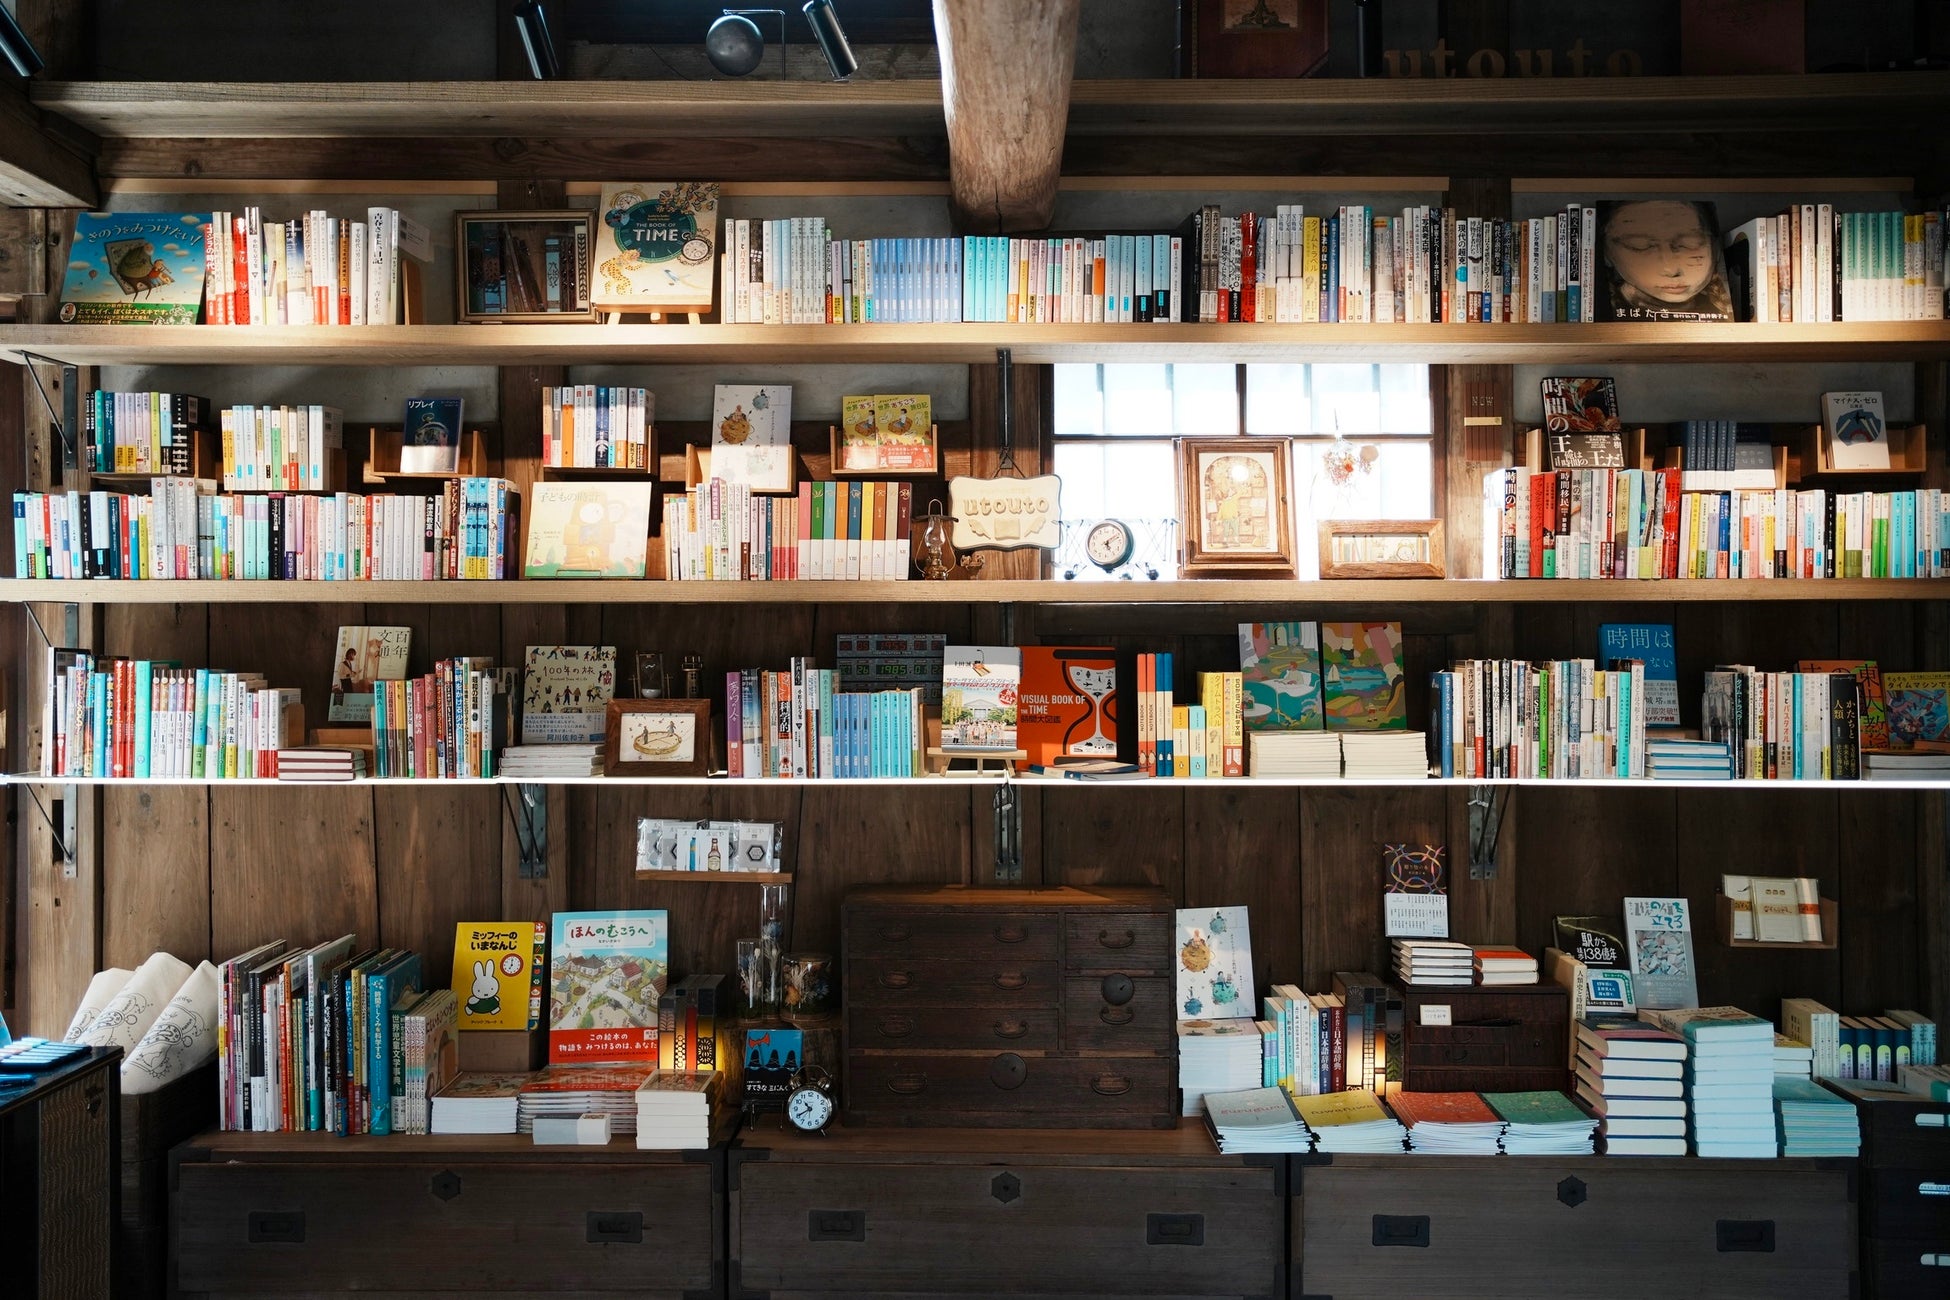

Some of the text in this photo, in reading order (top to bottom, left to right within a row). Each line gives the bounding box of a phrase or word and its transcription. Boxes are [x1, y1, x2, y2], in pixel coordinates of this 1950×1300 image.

[1382, 37, 1644, 79] utouto
[632, 228, 680, 242] TIME
[1311, 219, 1319, 272] タイムトラベル
[1457, 223, 1467, 265] 現代の超克
[739, 225, 747, 287] 戦争とバスタオル
[1616, 308, 1670, 318] まばたき
[408, 400, 435, 409] リプレイ
[1560, 472, 1570, 507] 時間移民
[963, 496, 1050, 516] utouto
[157, 561, 164, 571] 5
[375, 629, 393, 658] 文通
[393, 630, 410, 659] 百年
[1607, 627, 1672, 649] 時間は
[543, 665, 595, 677] 100年の旅
[857, 665, 869, 674] 26
[880, 665, 907, 674] 1985
[1020, 694, 1086, 704] VISUAL BOOK OF
[1214, 675, 1222, 727] タイムトラベル
[1029, 705, 1048, 714] TIME
[1783, 680, 1791, 743] 戦争とバスタオル
[1833, 700, 1844, 719] 人類
[1020, 715, 1062, 724] 時間大図鑑
[1846, 700, 1856, 740] かたちと
[546, 733, 585, 742] 阿川佐和子
[471, 930, 518, 940] ミッフィーの
[570, 924, 649, 938] ほんのむこうへ
[470, 941, 518, 950] いまなんじ
[1581, 932, 1607, 948] 駅から
[589, 1033, 628, 1042] この絵本の
[391, 1014, 401, 1085] 世界児童文学事典
[558, 1042, 658, 1052] 物語を みつけるのは、あなた
